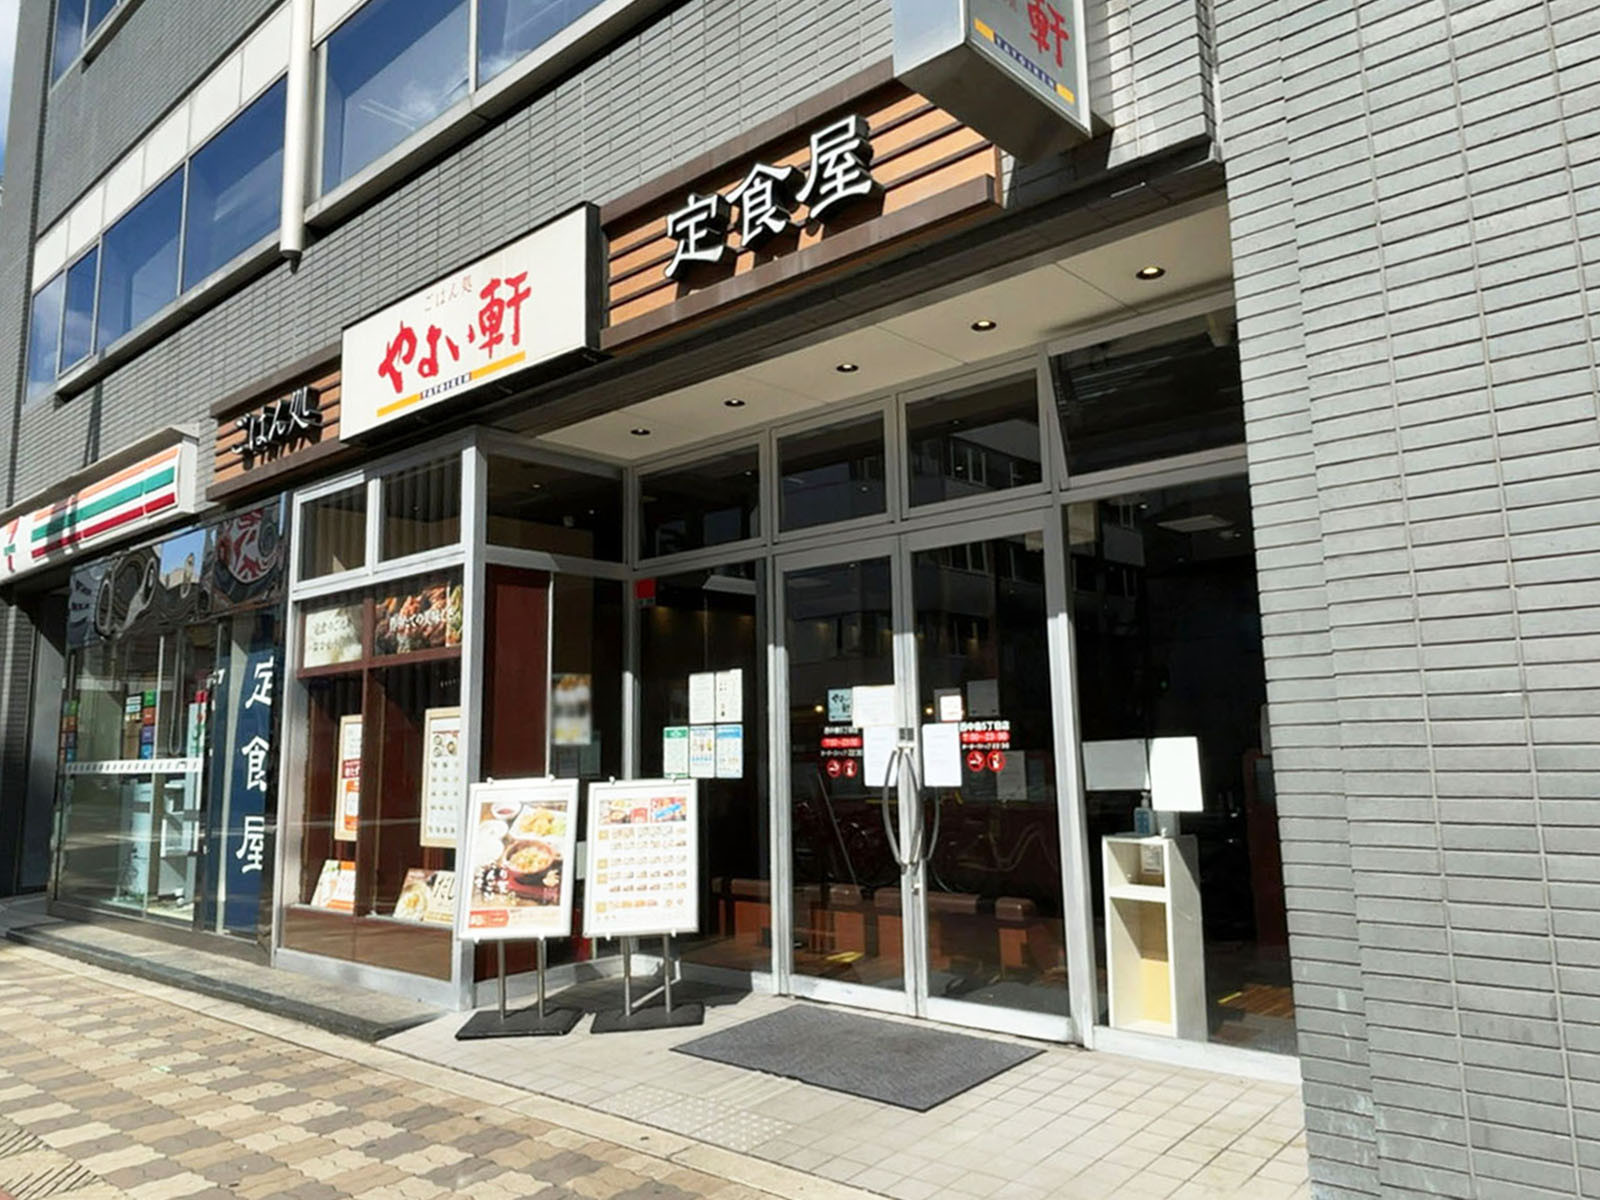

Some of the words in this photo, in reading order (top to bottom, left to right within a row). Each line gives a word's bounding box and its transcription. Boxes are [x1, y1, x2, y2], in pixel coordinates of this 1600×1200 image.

[664, 114, 873, 278] 定食屋
[378, 271, 531, 394] やよい軒
[231, 386, 310, 453] ごはん処
[236, 656, 274, 873] 定食屋
